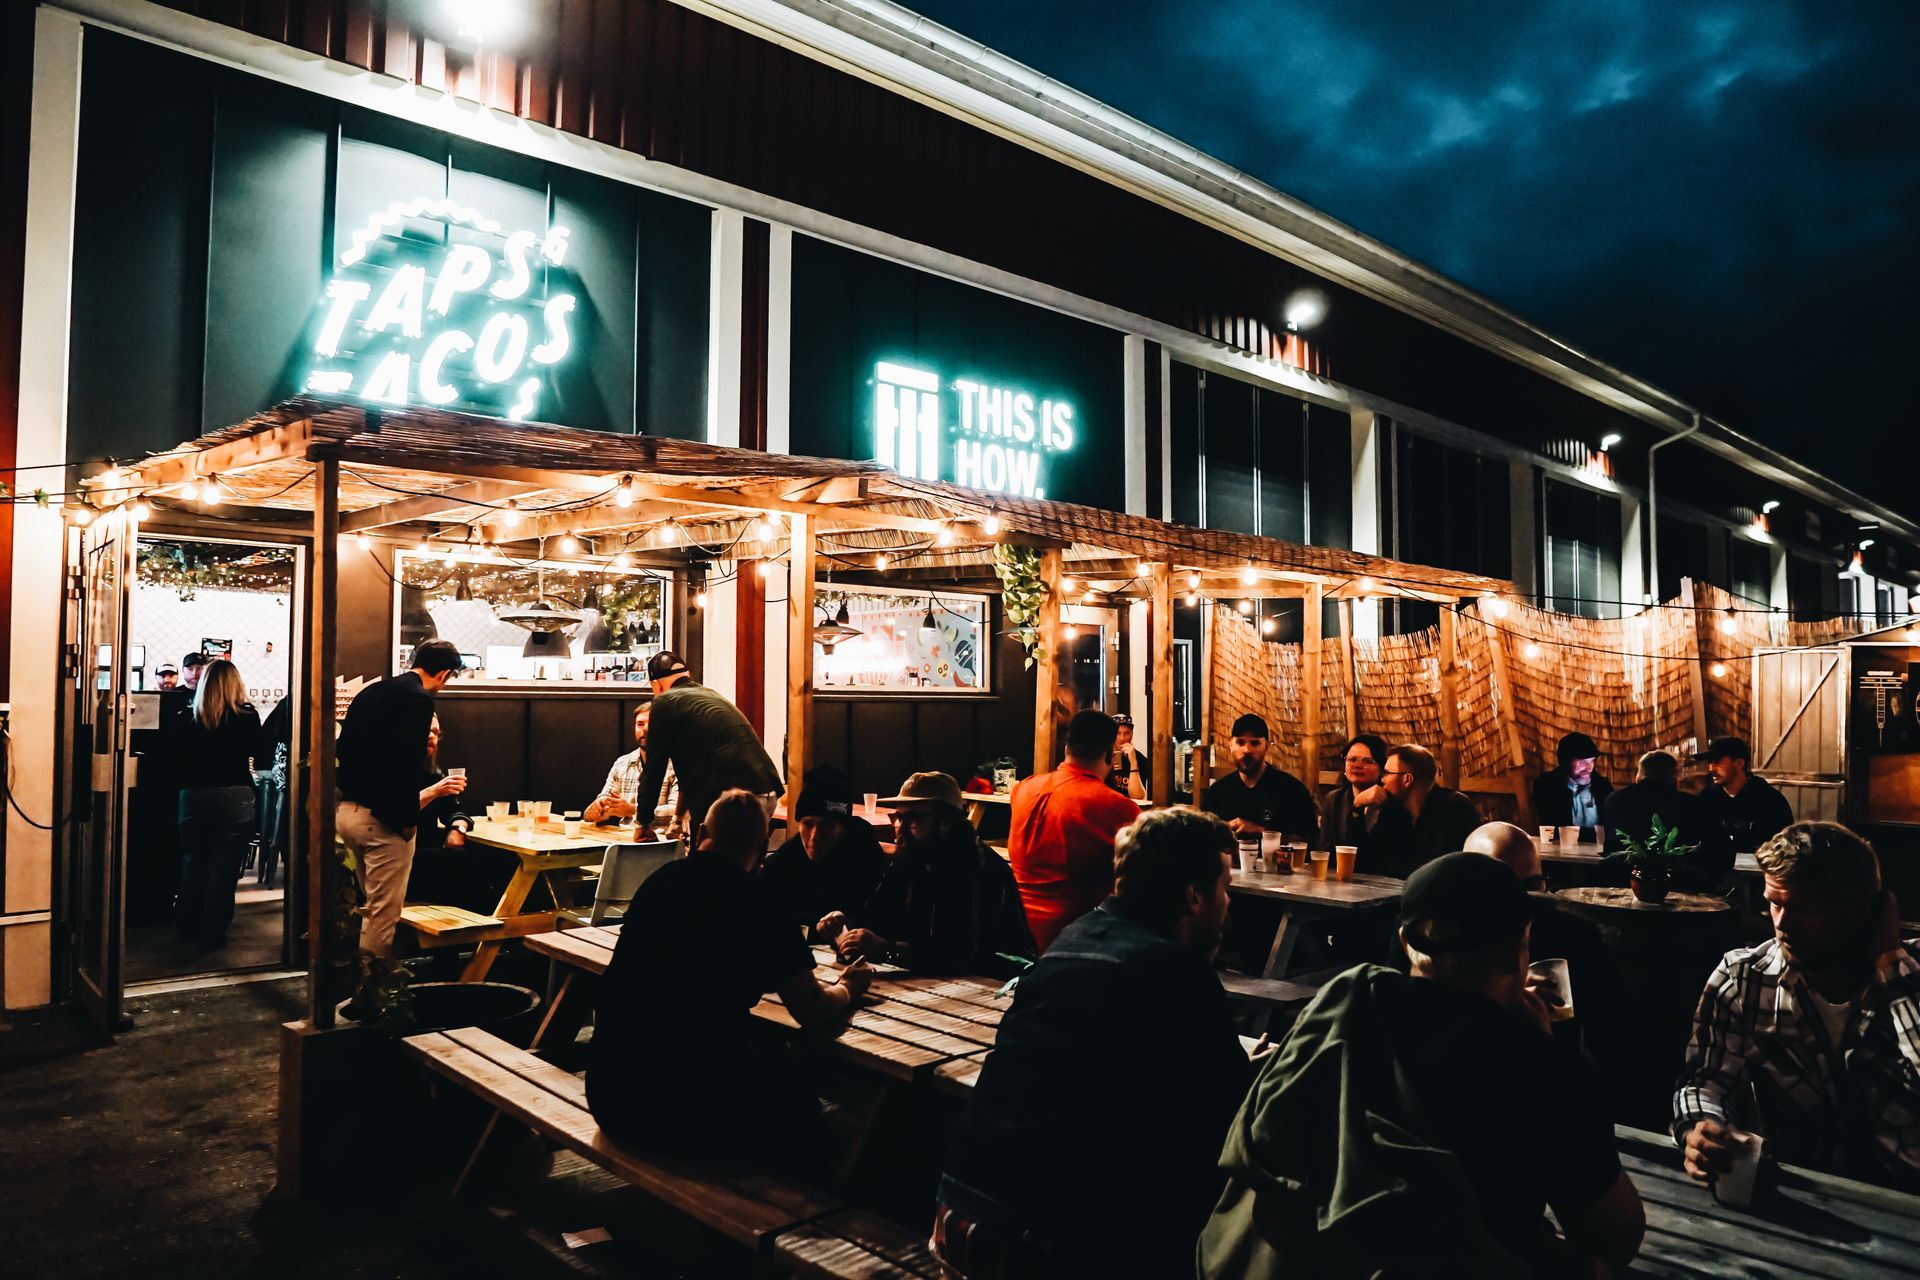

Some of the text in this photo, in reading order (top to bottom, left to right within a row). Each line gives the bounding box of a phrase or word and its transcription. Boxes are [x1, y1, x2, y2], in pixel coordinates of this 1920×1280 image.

[314, 230, 537, 358] TAPS
[306, 294, 577, 405] ACOS
[955, 379, 1073, 450] THIS IS
[955, 438, 1044, 500] HOW.
